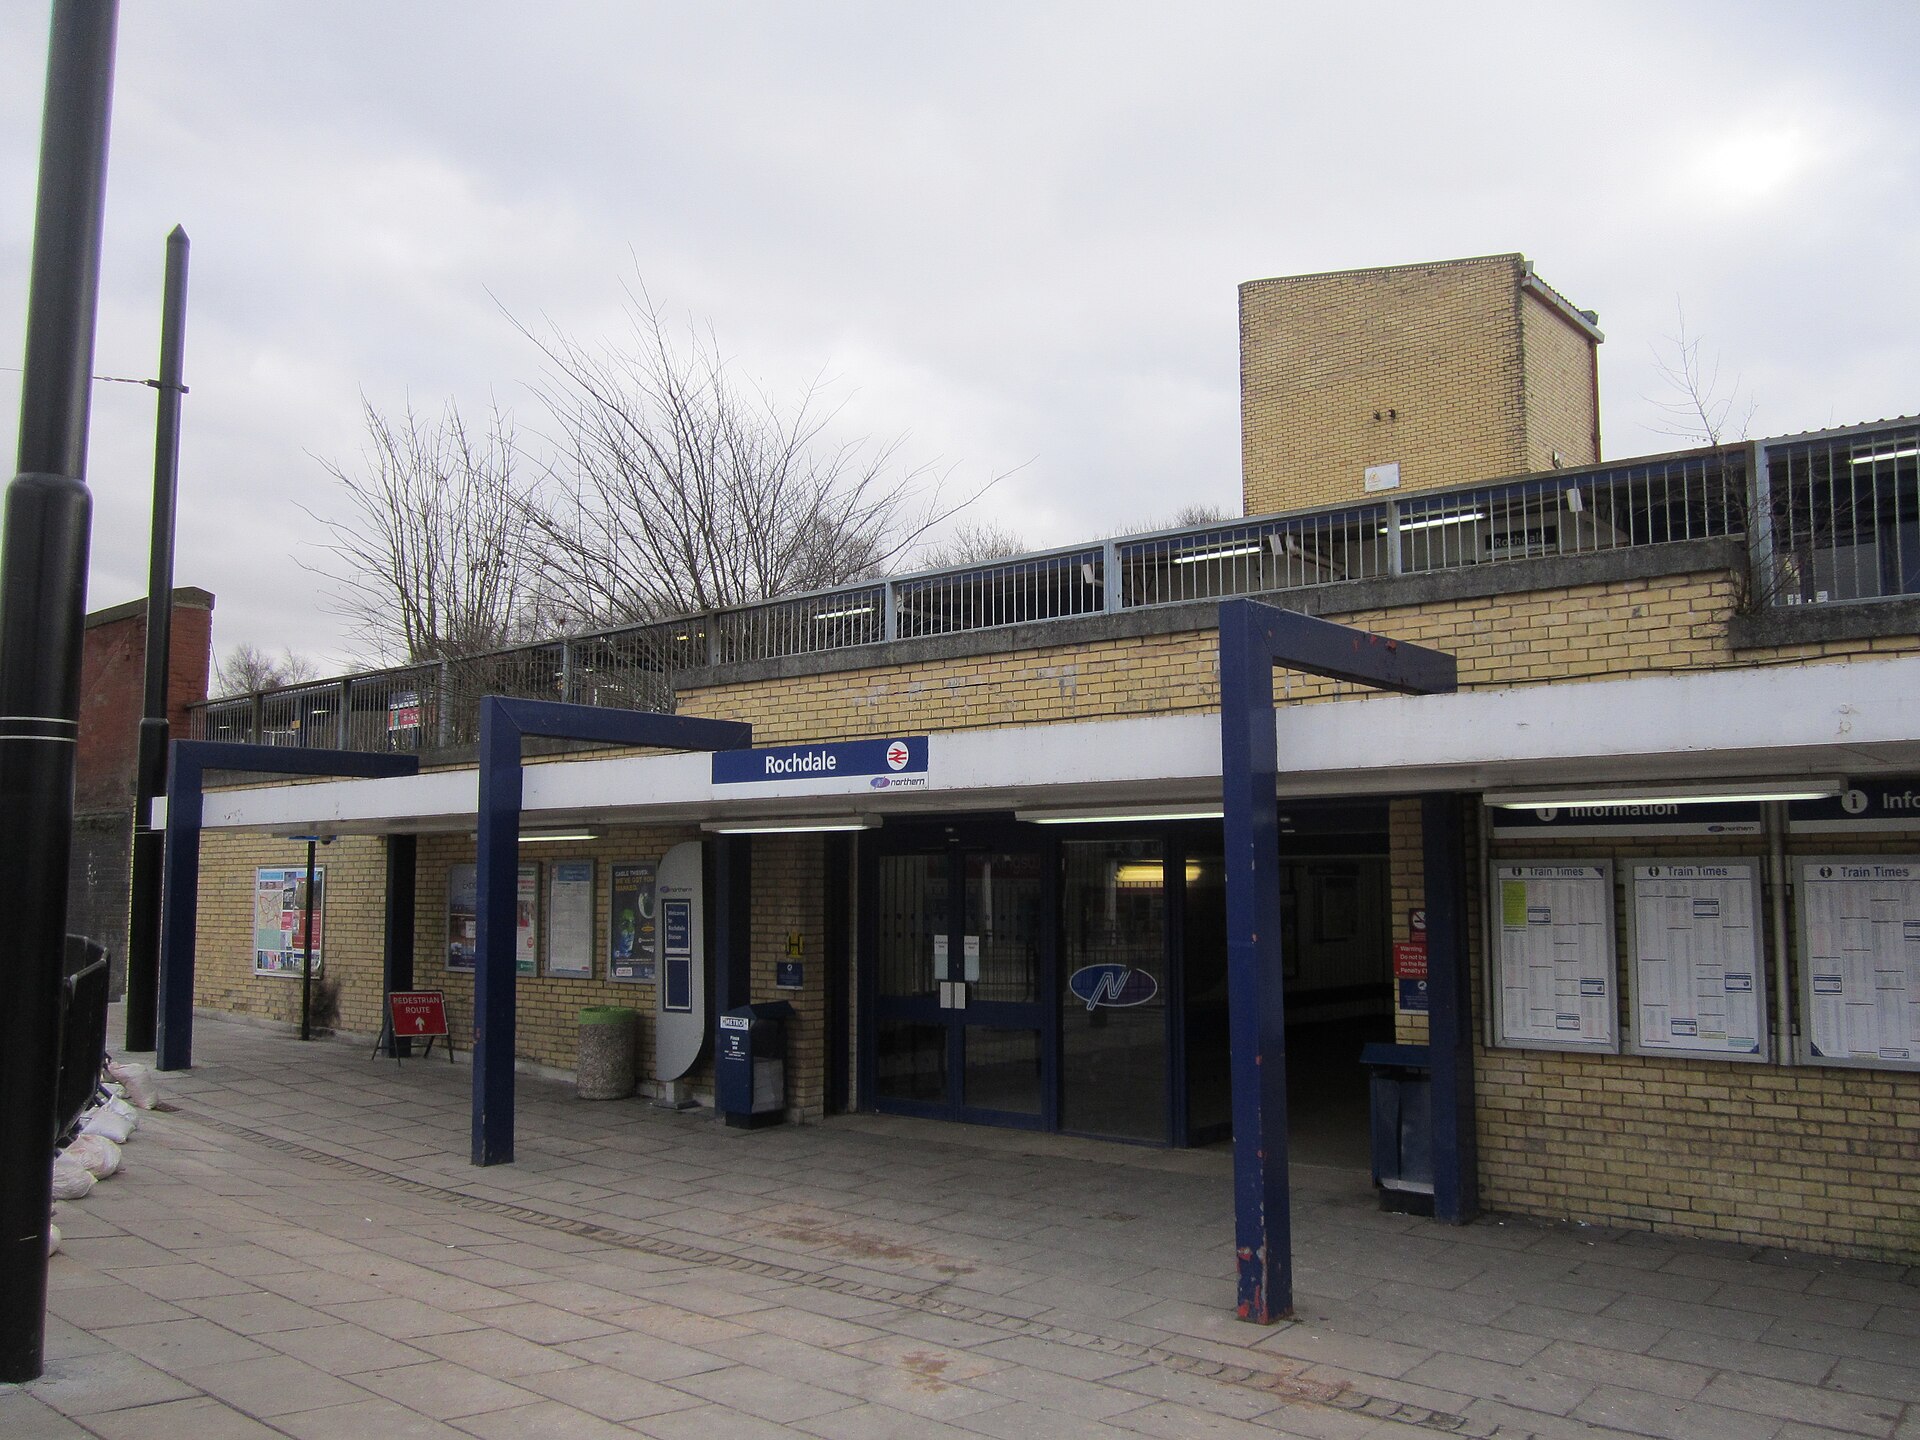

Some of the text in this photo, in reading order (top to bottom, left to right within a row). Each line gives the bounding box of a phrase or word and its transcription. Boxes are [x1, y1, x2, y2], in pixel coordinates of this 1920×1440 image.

[765, 750, 837, 774] Rochdale
[891, 777, 925, 786] northern
[1667, 866, 1728, 877] Train Times
[1841, 866, 1910, 878] Train Times
[393, 996, 440, 1004] PEDESTRIAN
[405, 1006, 431, 1014] ROUTE
